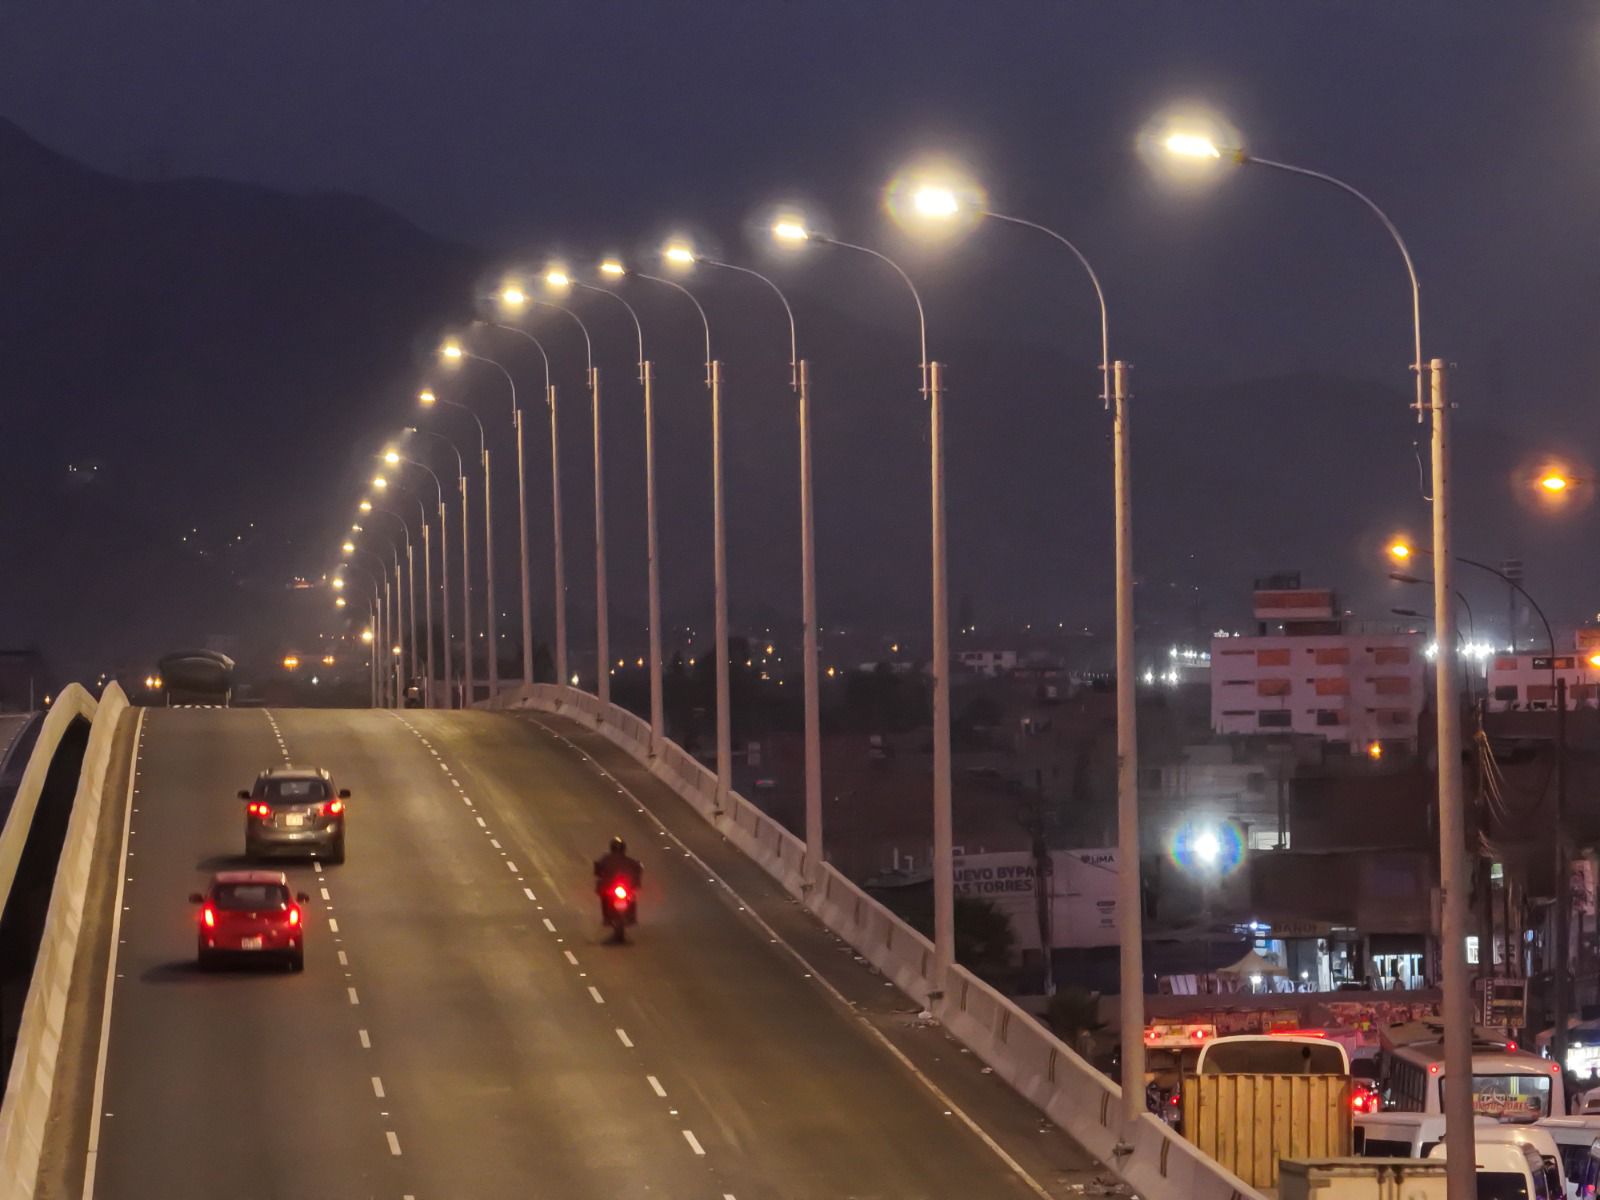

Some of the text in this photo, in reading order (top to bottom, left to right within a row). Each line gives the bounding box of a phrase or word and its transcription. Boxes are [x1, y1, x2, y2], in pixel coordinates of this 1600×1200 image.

[1091, 855, 1114, 865] LIMA
[953, 866, 1054, 882] UEVO BYPAS
[953, 880, 1033, 895] AS TORRES
